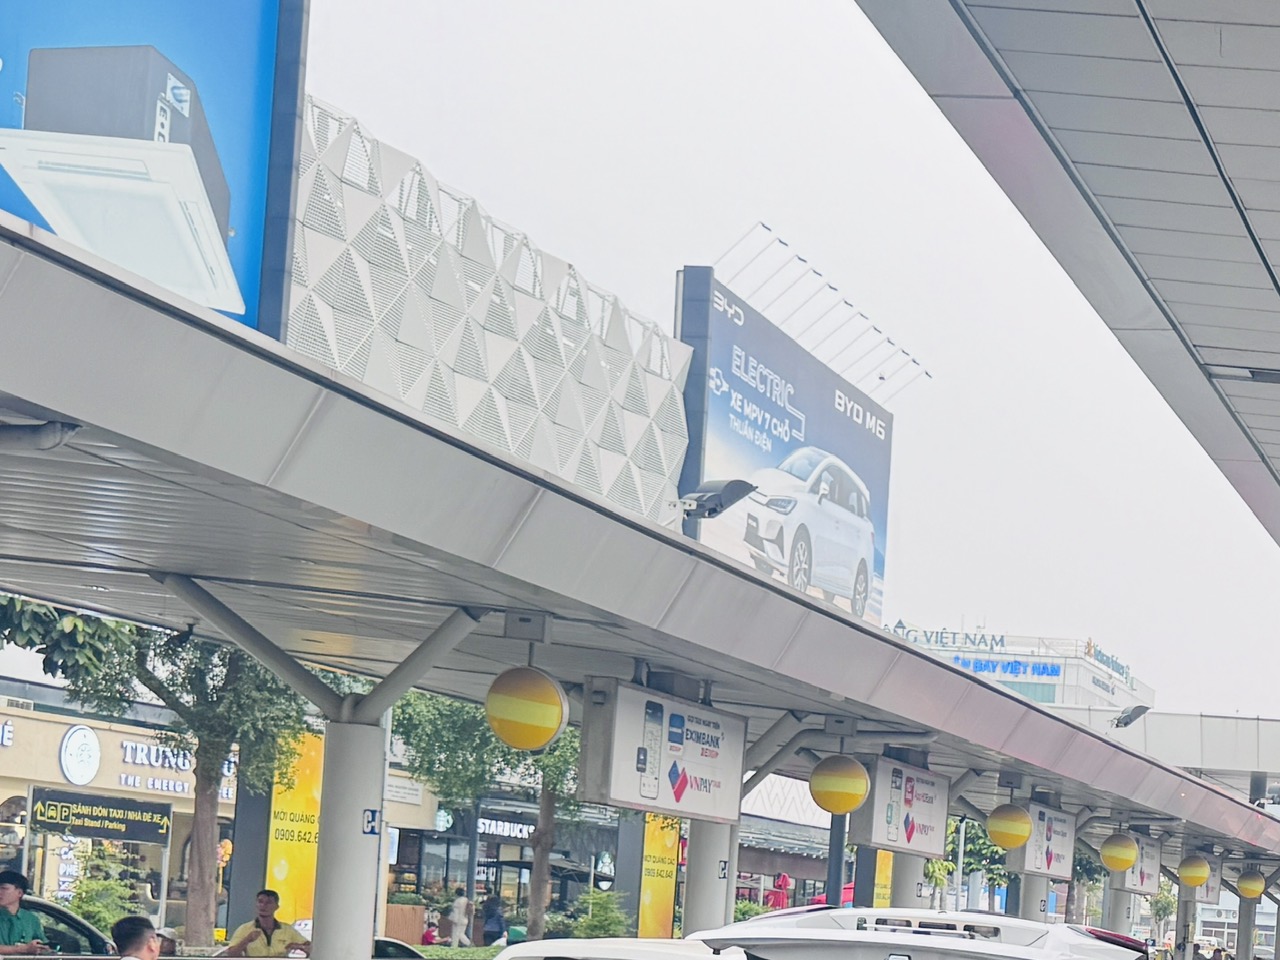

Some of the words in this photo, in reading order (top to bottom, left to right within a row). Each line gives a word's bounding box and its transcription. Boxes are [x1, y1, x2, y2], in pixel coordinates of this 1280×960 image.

[732, 344, 796, 413] ELECTRIC
[730, 389, 743, 412] XE
[743, 399, 764, 426] MPV
[764, 408, 772, 429] 7
[771, 413, 792, 443] CHỖ
[834, 389, 864, 425] BYD
[866, 413, 887, 441] M6
[923, 627, 958, 647] VIỆT
[965, 633, 1006, 651] NAM
[973, 659, 998, 673] BAY
[1001, 660, 1028, 677] VIỆT
[1031, 662, 1061, 677] NAM
[121, 740, 191, 771] TRUNG
[119, 773, 141, 788] THE
[61, 808, 70, 820] P
[72, 803, 91, 816] SẢNH
[92, 806, 108, 819] ĐÓN
[109, 808, 124, 820] TAXI
[153, 813, 162, 824] XE
[71, 816, 83, 826] Taxi
[105, 820, 126, 832] Parking
[273, 809, 288, 821] MỜI
[289, 809, 316, 825] QUẢNG
